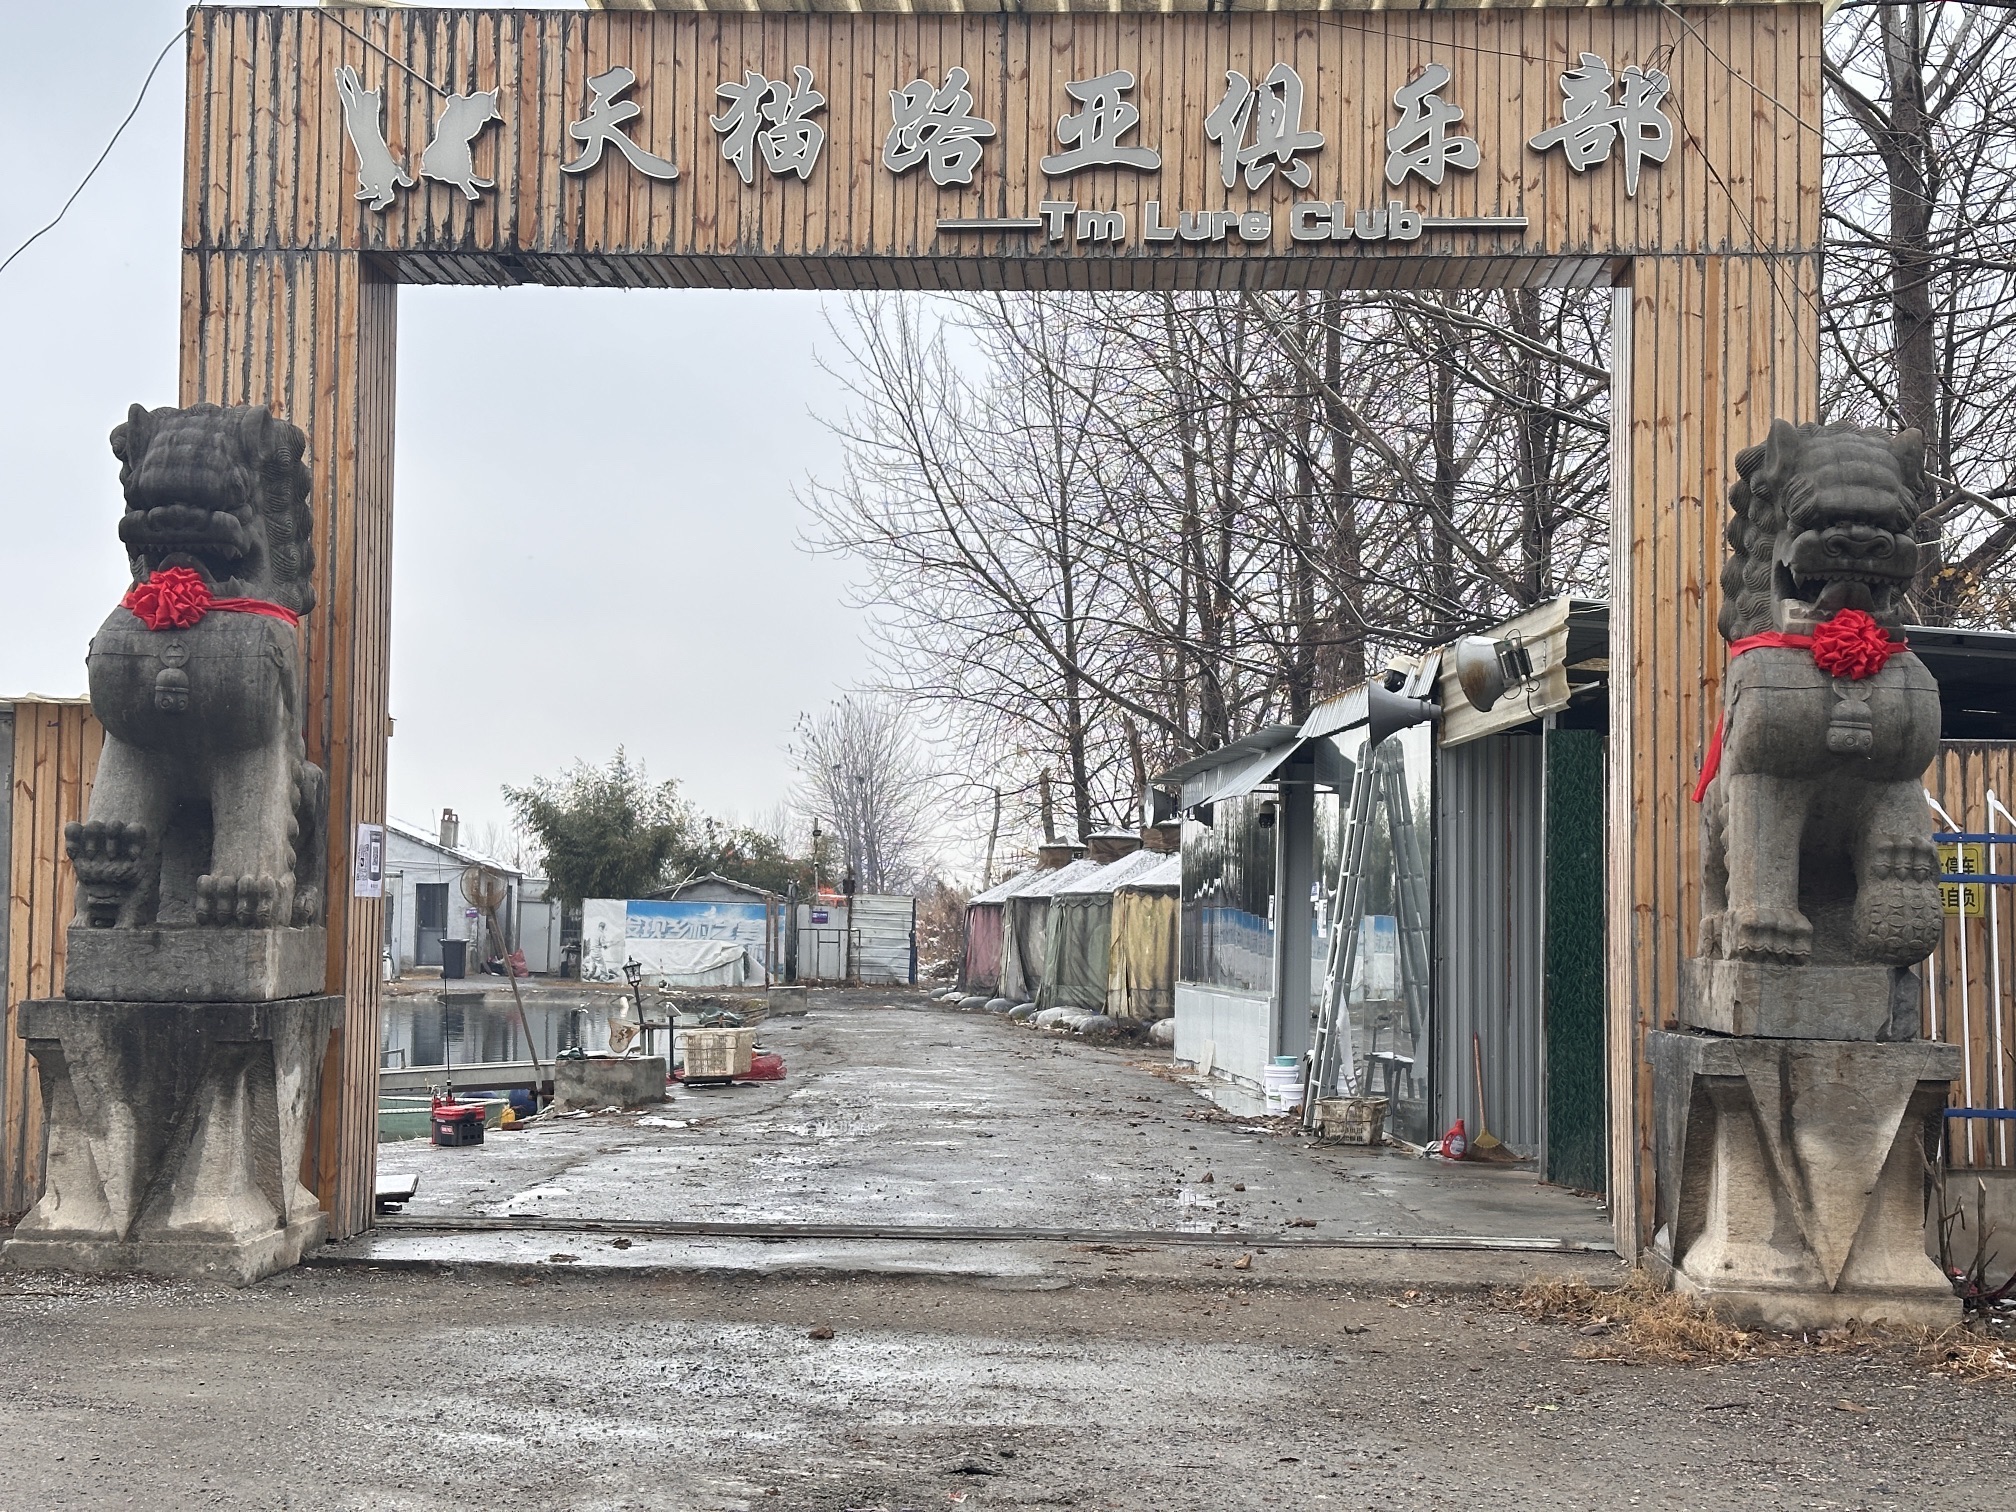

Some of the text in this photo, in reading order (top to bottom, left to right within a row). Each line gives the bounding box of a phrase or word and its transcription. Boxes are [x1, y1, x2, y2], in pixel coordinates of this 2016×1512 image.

[559, 52, 1674, 197] 天猫路亚俱乐部
[1039, 200, 1424, 242] Tm Lure Club
[1941, 856, 1976, 875] 停车
